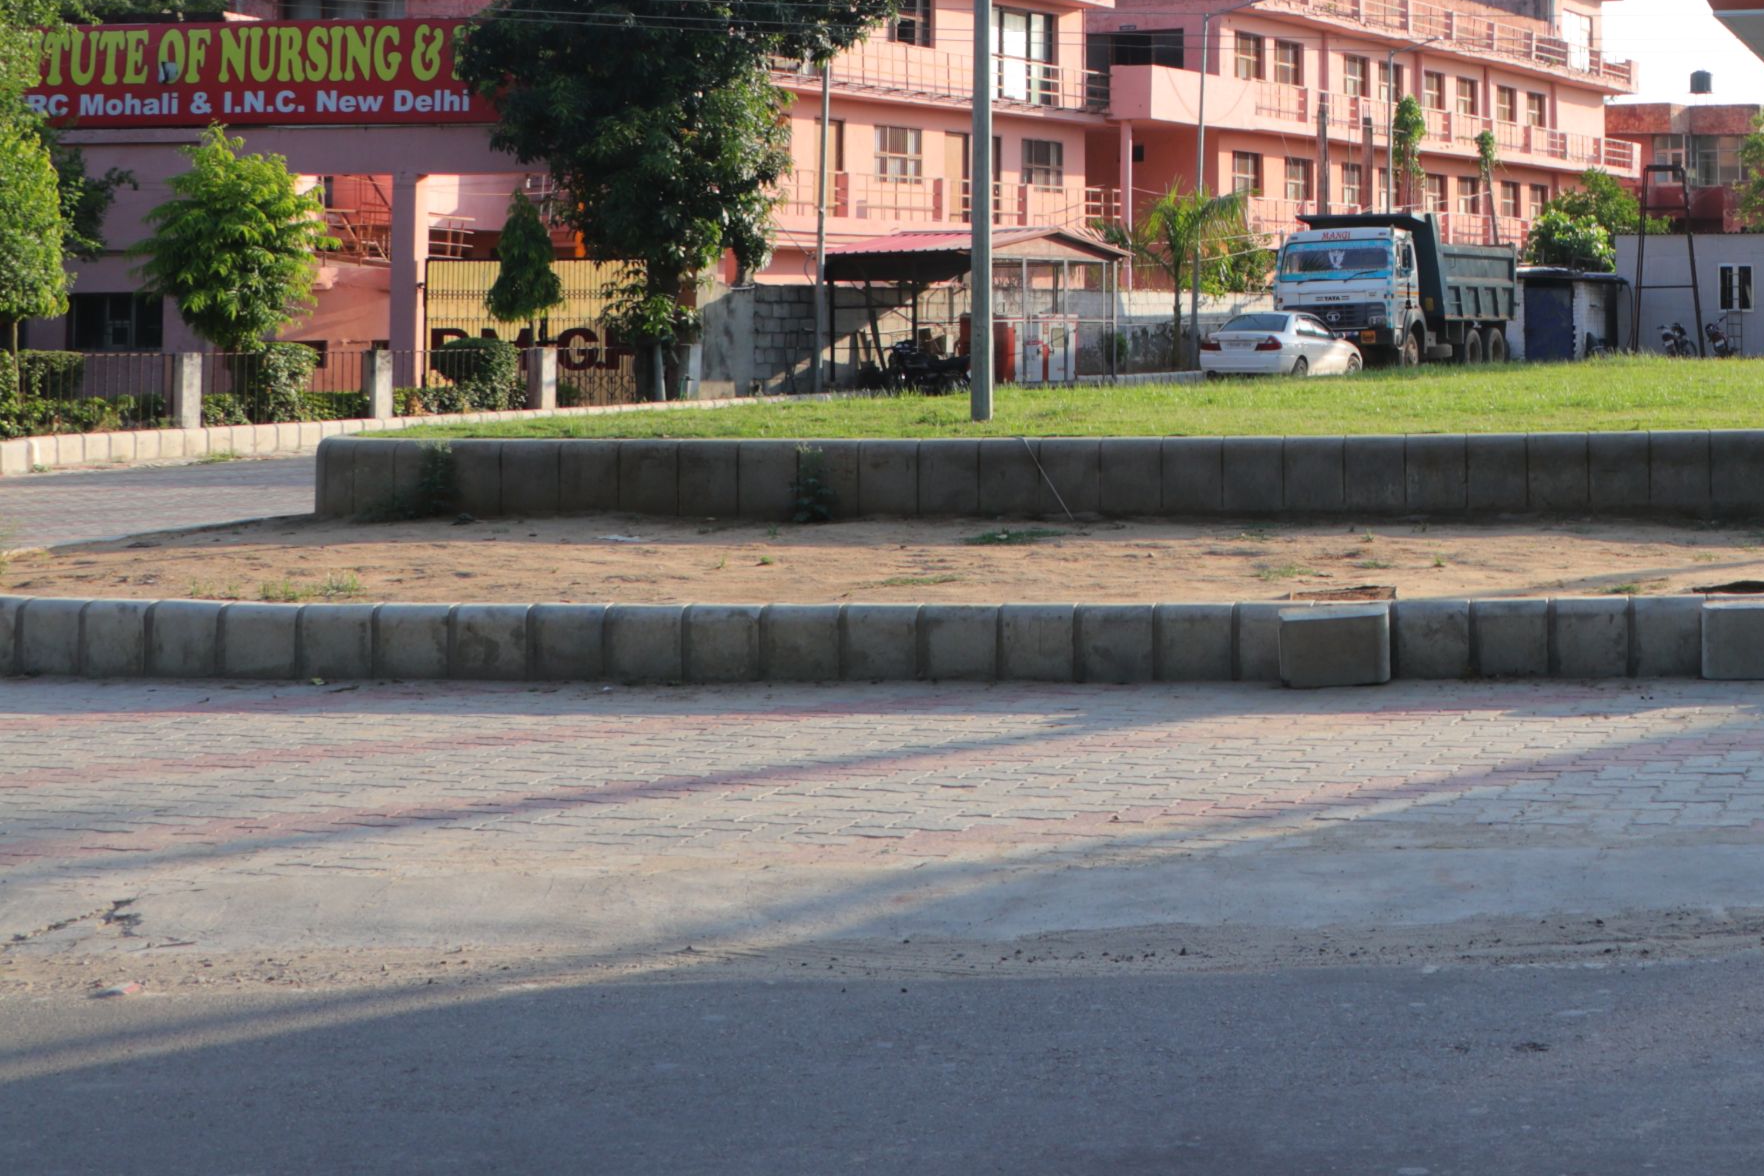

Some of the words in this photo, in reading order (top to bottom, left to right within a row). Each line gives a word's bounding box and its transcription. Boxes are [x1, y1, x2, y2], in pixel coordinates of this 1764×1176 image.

[158, 28, 212, 84] OF
[218, 25, 403, 83] NURSING
[411, 23, 444, 82] &
[25, 94, 69, 117] RC
[80, 92, 179, 117] Mohali
[190, 91, 212, 114] &
[223, 90, 306, 114] I.N.C.
[316, 90, 384, 113] New
[393, 89, 470, 112] Delhi
